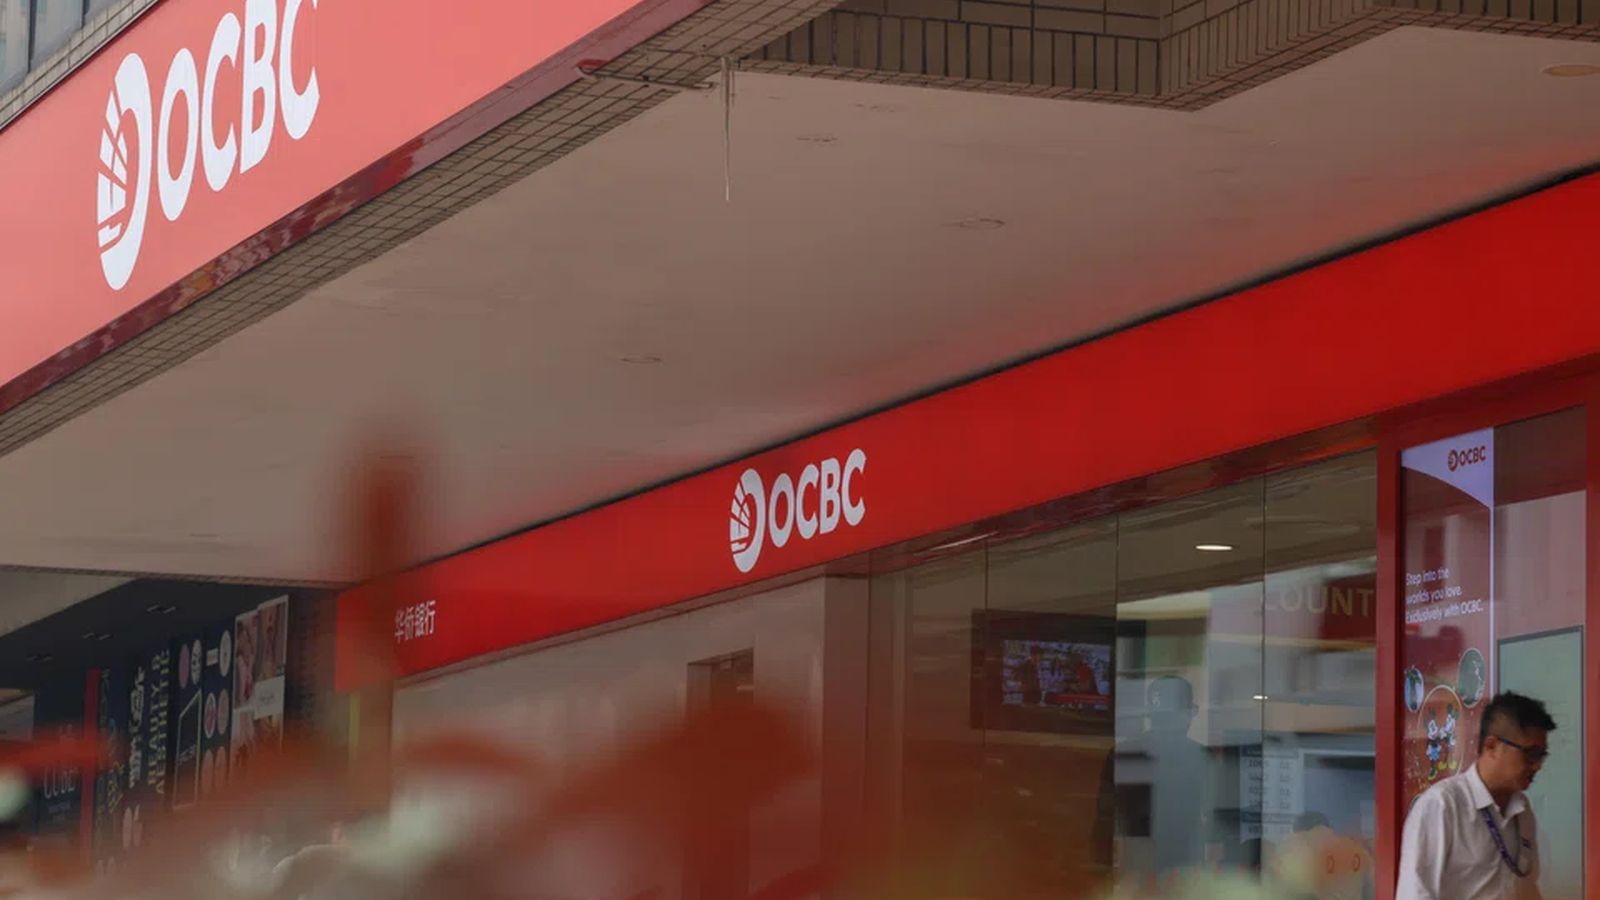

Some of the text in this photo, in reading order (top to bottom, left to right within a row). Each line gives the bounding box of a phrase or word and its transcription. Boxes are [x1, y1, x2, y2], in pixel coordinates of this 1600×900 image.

[157, 0, 320, 222] OCBC
[1459, 445, 1486, 467] OCBC
[768, 448, 867, 548] OCBC
[1406, 573, 1422, 587] Step
[1430, 589, 1445, 603] you
[394, 600, 436, 644] 华侨银行
[147, 684, 161, 785] BEAUTY
